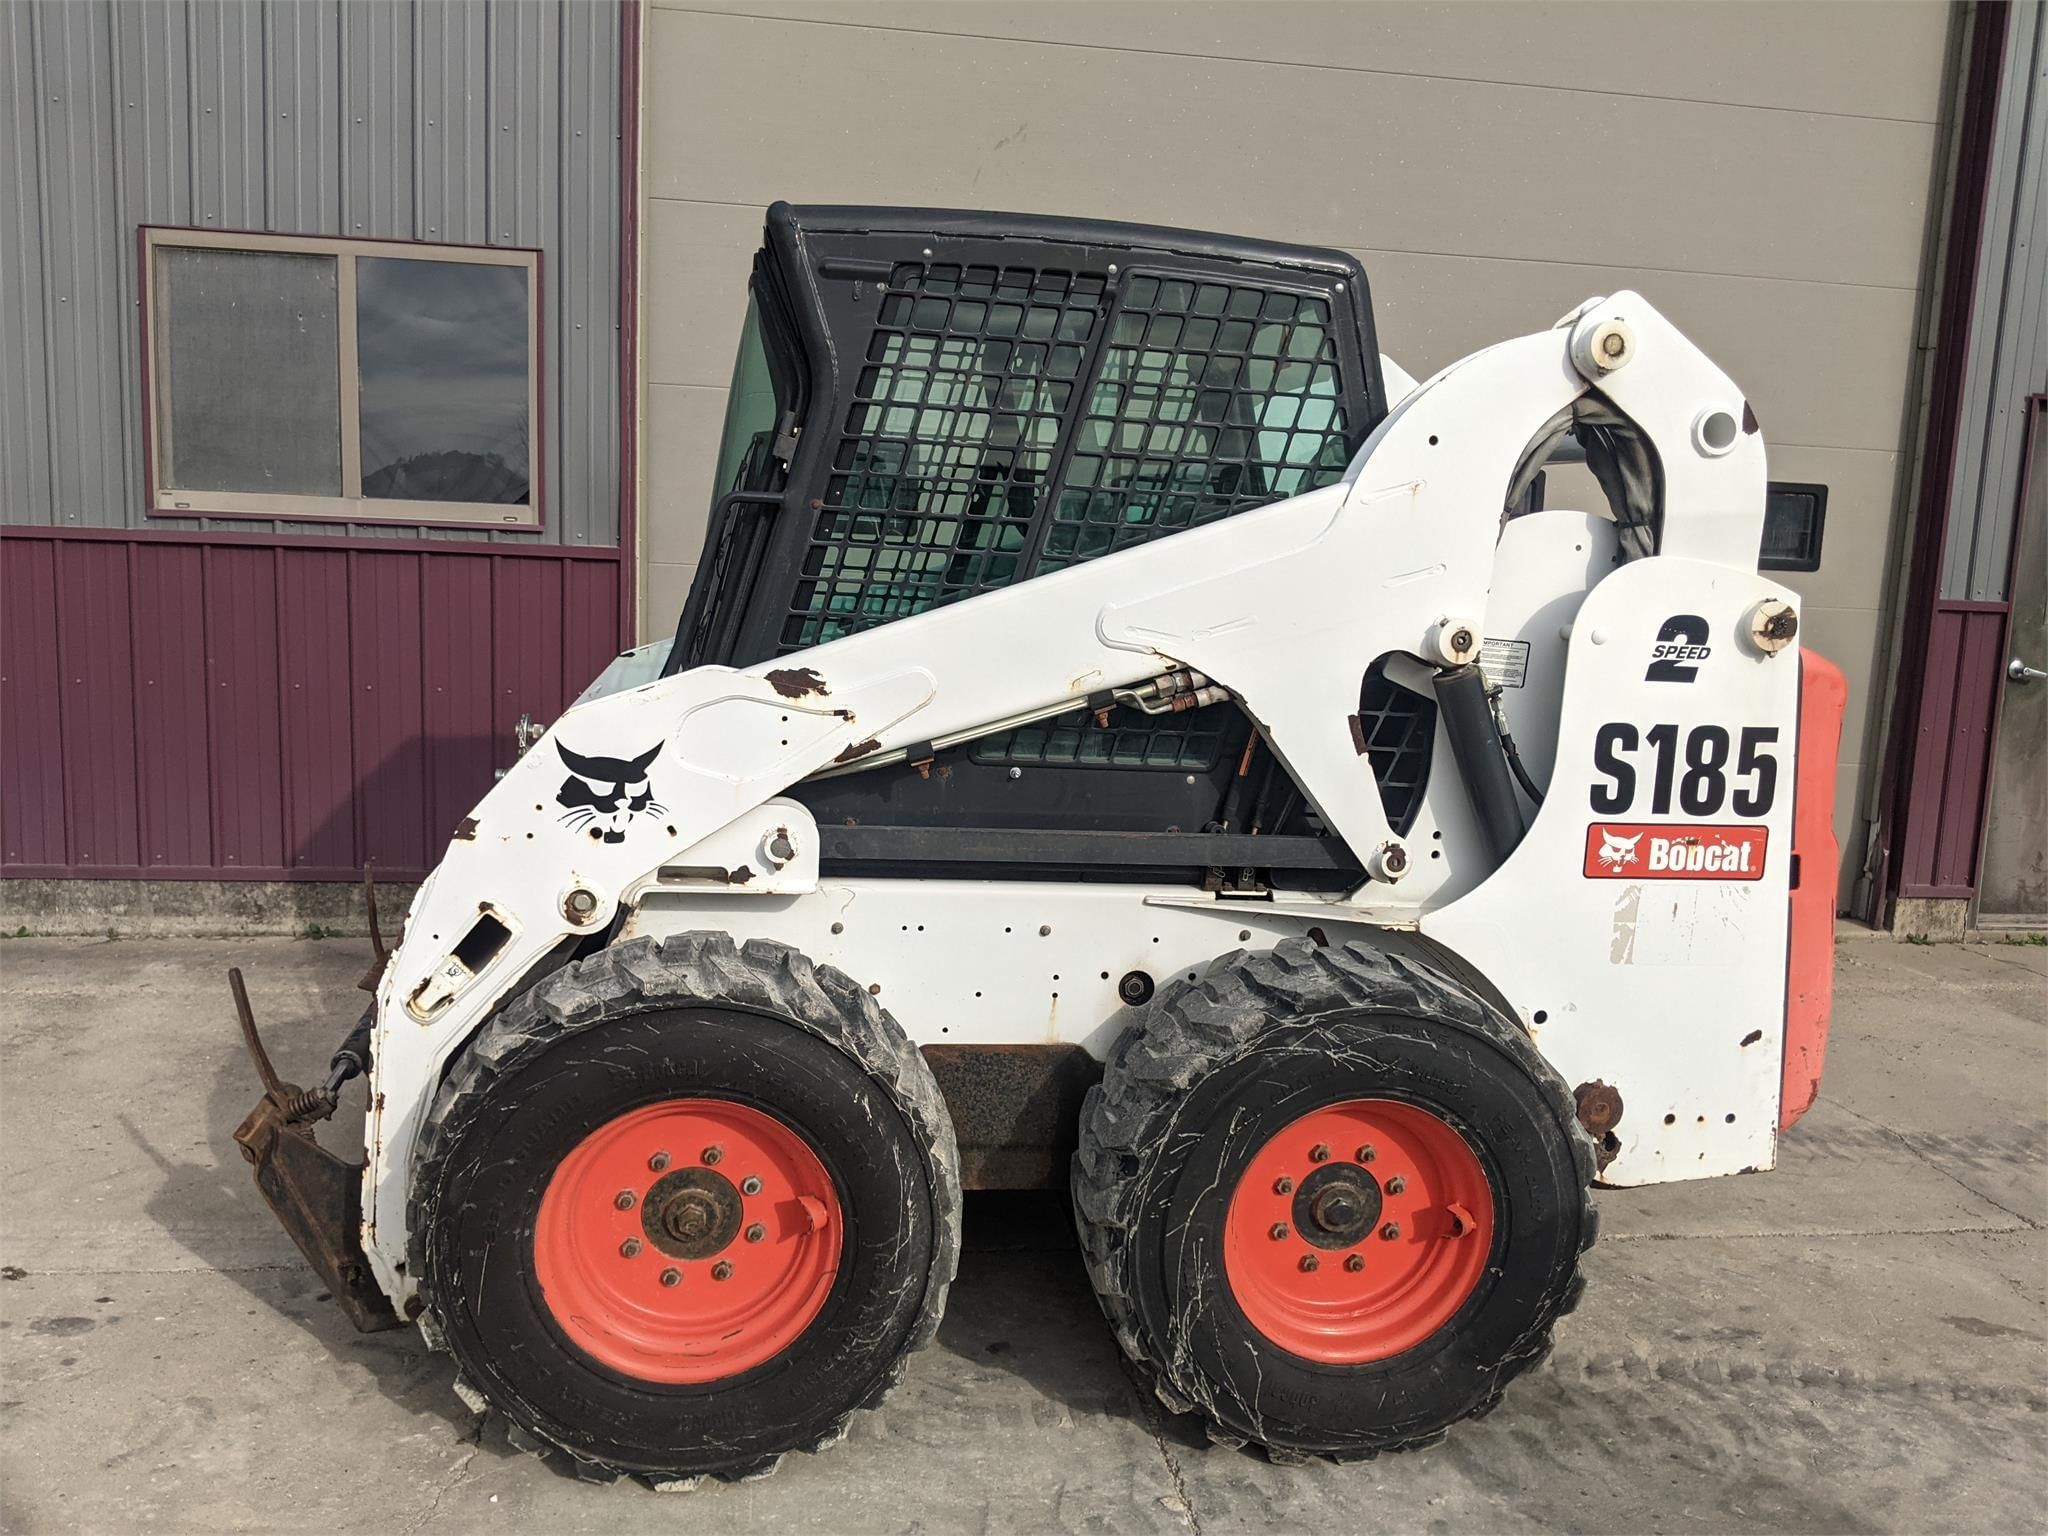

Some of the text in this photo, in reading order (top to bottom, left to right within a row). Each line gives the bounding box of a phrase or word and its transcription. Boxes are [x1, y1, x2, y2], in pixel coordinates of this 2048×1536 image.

[1483, 641, 1514, 649] MPORTANT
[1644, 615, 1710, 683] 2
[1651, 645, 1710, 661] SPEED
[1590, 722, 1779, 817] S185
[1649, 838, 1755, 873] Bobcat
